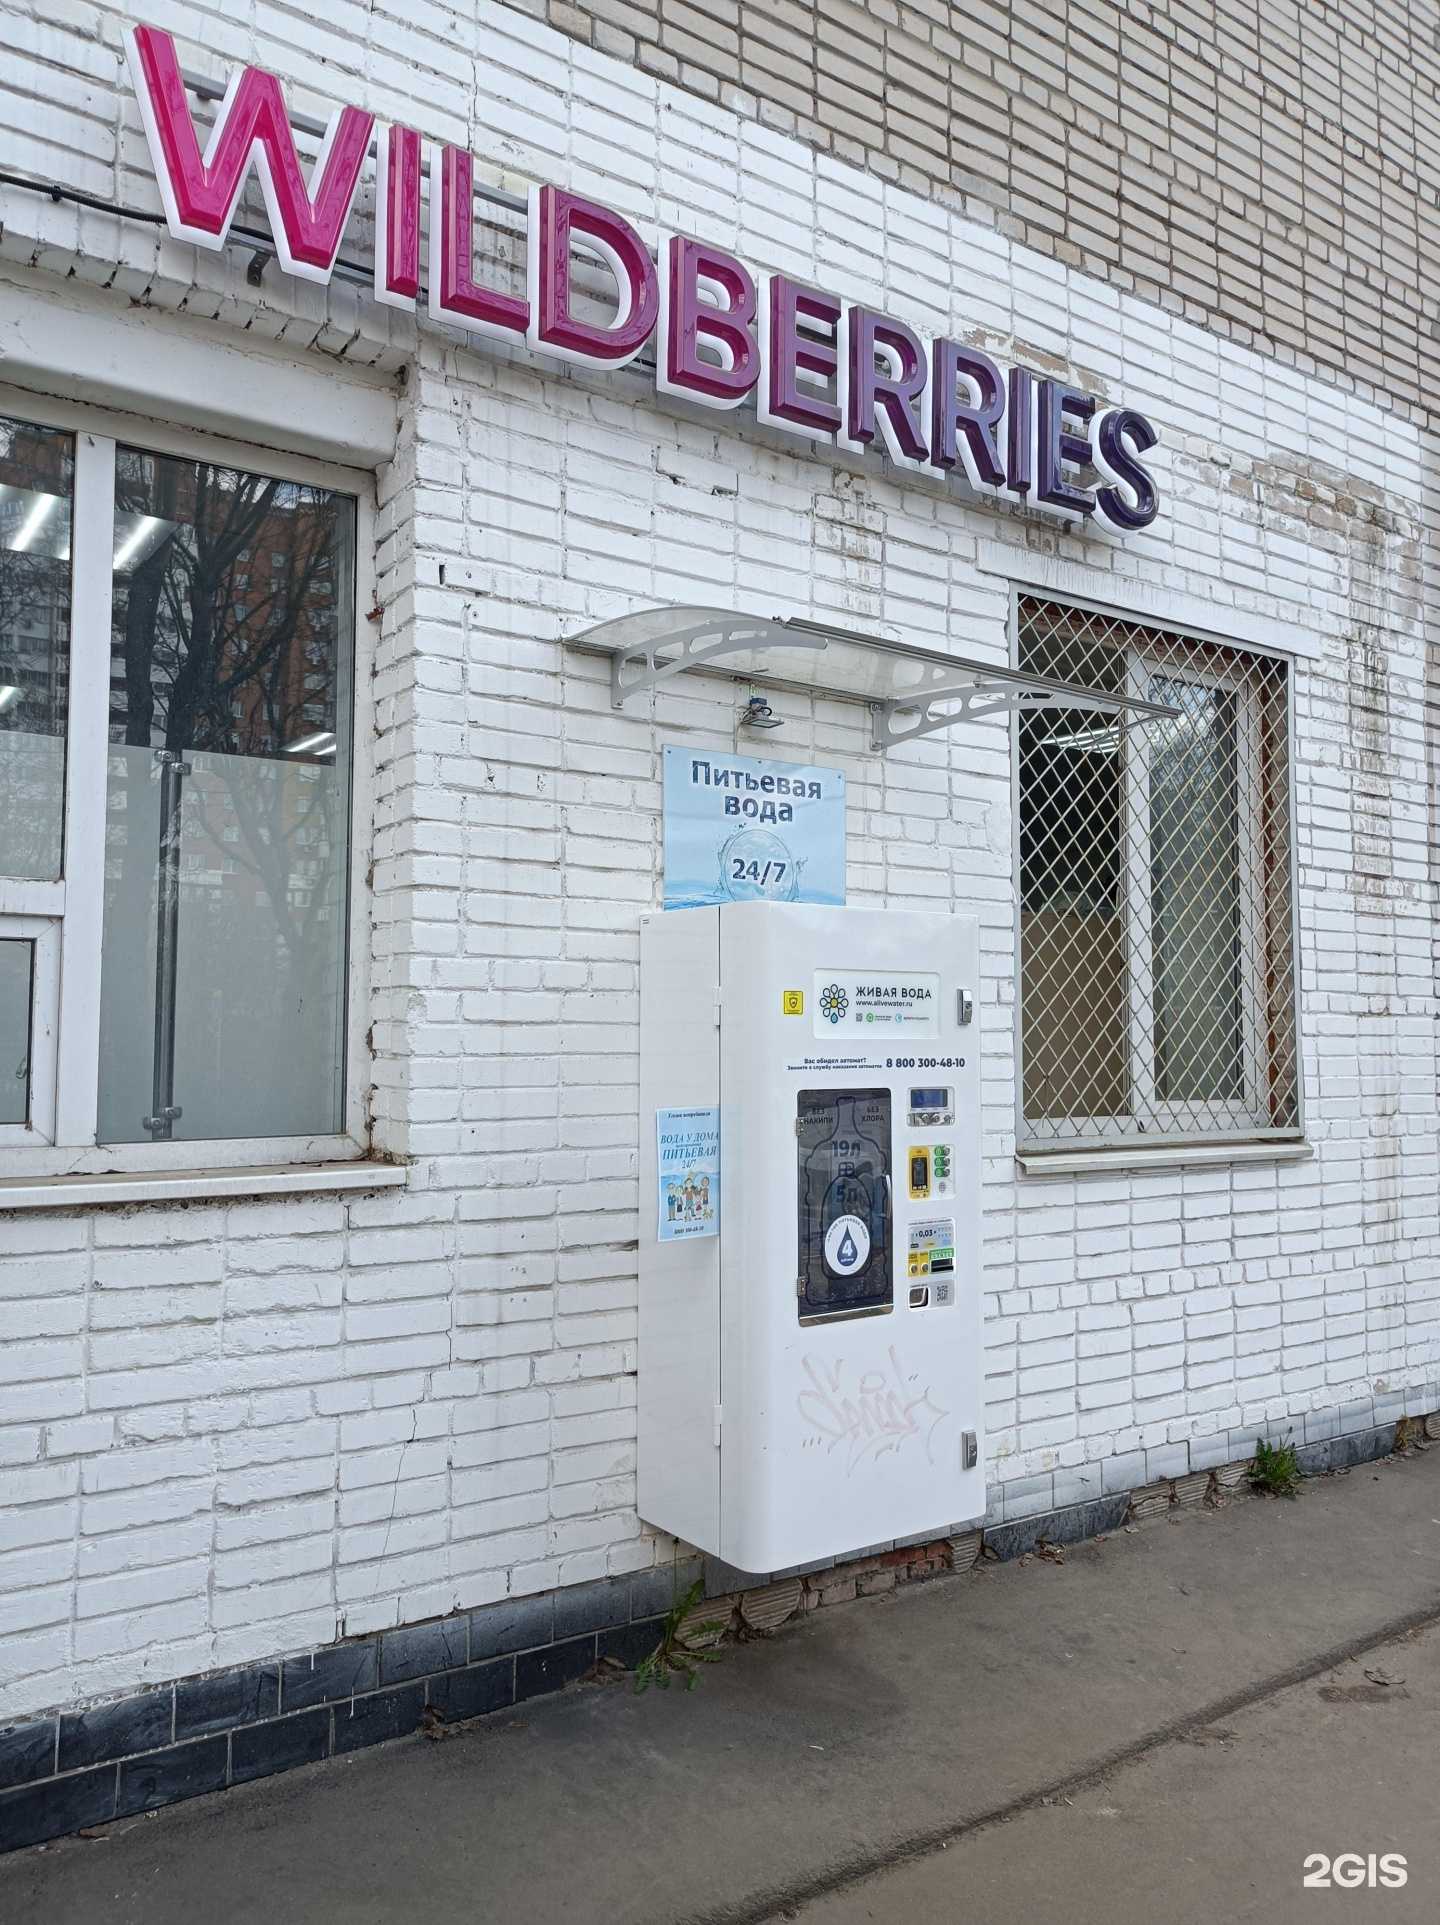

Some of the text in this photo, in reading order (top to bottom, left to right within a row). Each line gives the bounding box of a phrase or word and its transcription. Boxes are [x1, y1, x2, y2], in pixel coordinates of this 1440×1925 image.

[122, 24, 1160, 537] WILDBERRIES
[691, 760, 822, 799] Питьевая
[724, 795, 793, 824] вода
[732, 858, 786, 885] 24/7
[856, 986, 932, 1000] ЖИВАЯ ВОДА
[856, 999, 912, 1007] www.alivewater.ru
[886, 1058, 965, 1068] 8 800 300-48-10
[660, 1131, 719, 1144] ВОДА У ДОМА
[663, 1145, 717, 1160] ПИТЬЕВАЯ
[842, 1239, 853, 1257] 4
